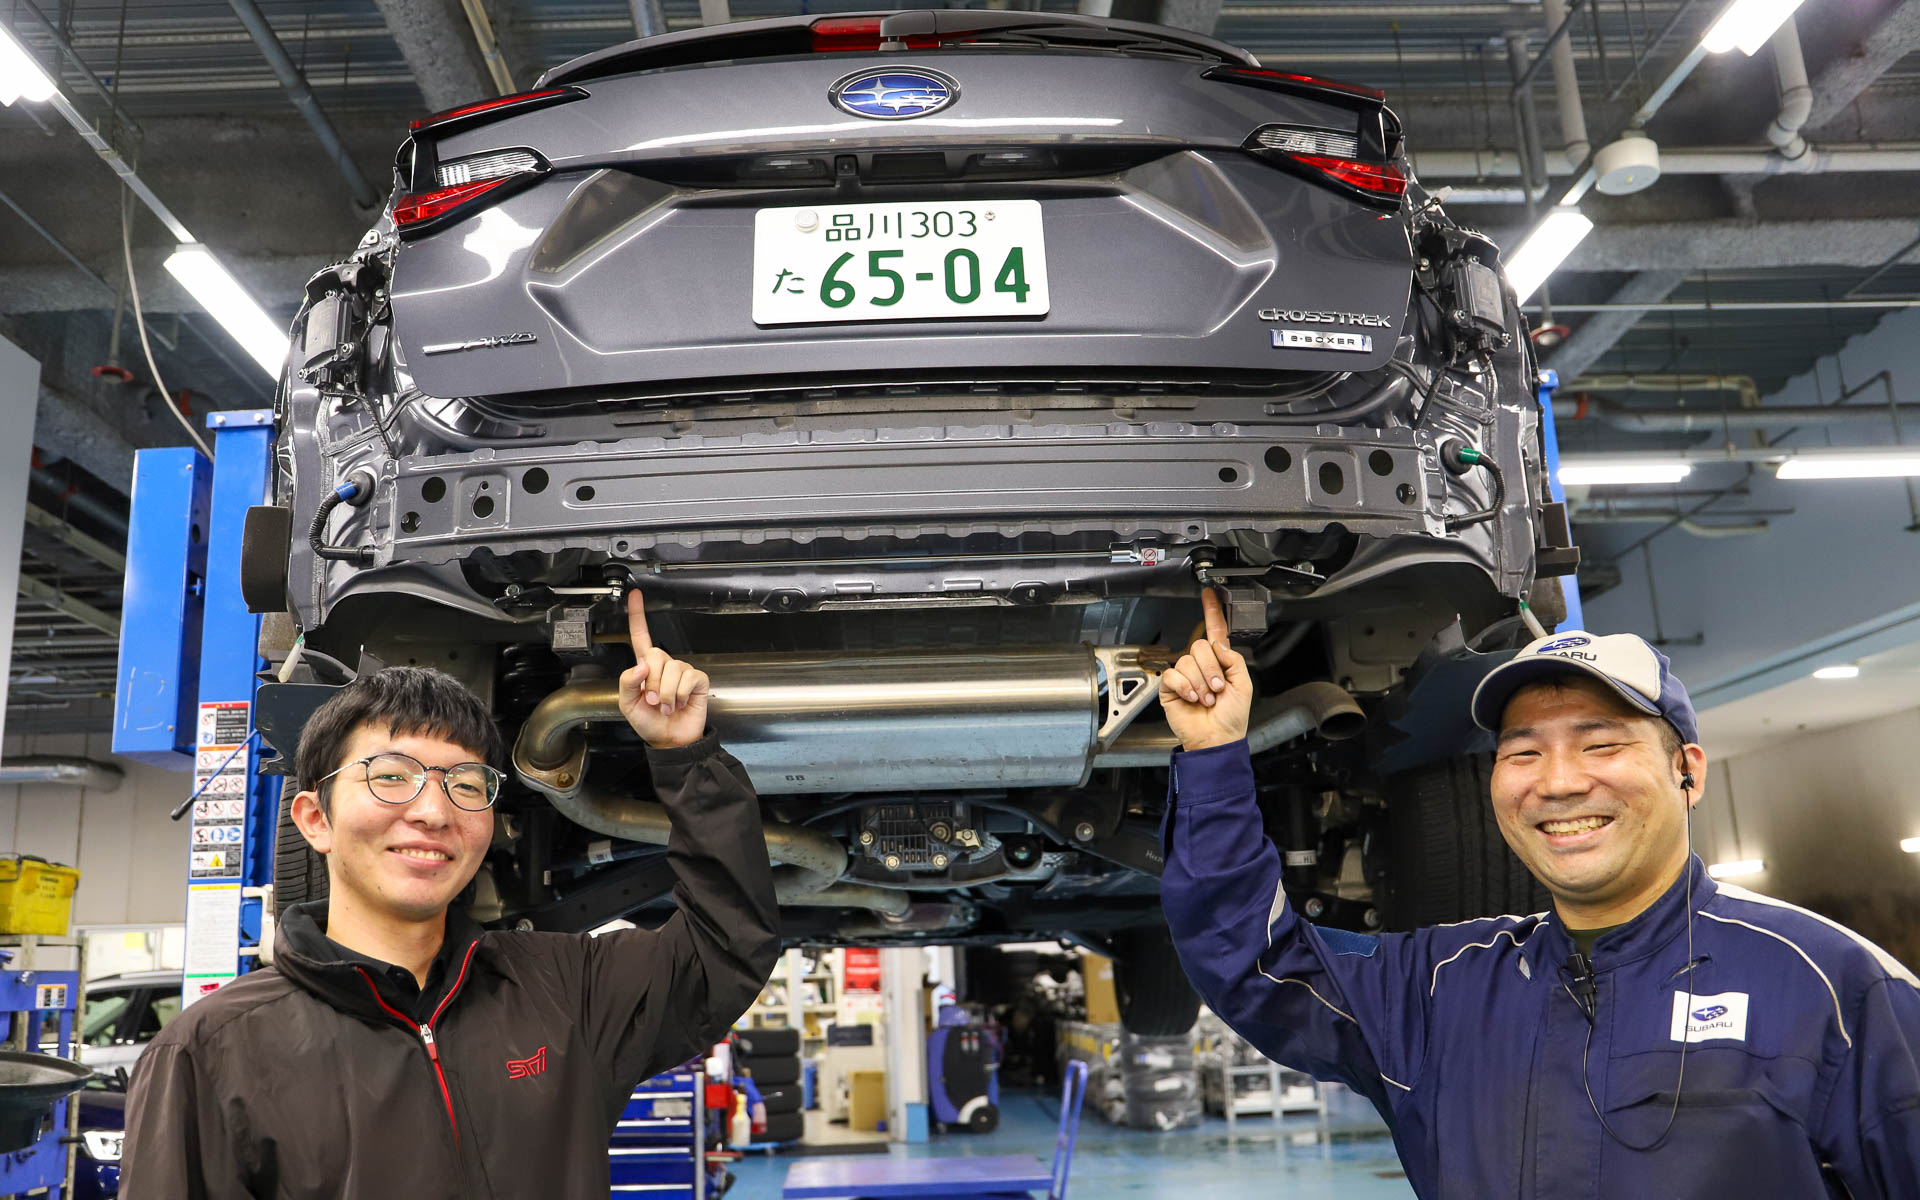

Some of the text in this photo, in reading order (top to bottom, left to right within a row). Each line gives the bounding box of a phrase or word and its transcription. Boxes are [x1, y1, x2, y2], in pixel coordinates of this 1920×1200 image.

[772, 247, 1031, 308] た 65-04
[1257, 308, 1392, 328] CROSSTREK
[1553, 651, 1597, 661] ARU
[1685, 1021, 1733, 1032] SUBARU
[506, 1046, 547, 1079] STI
